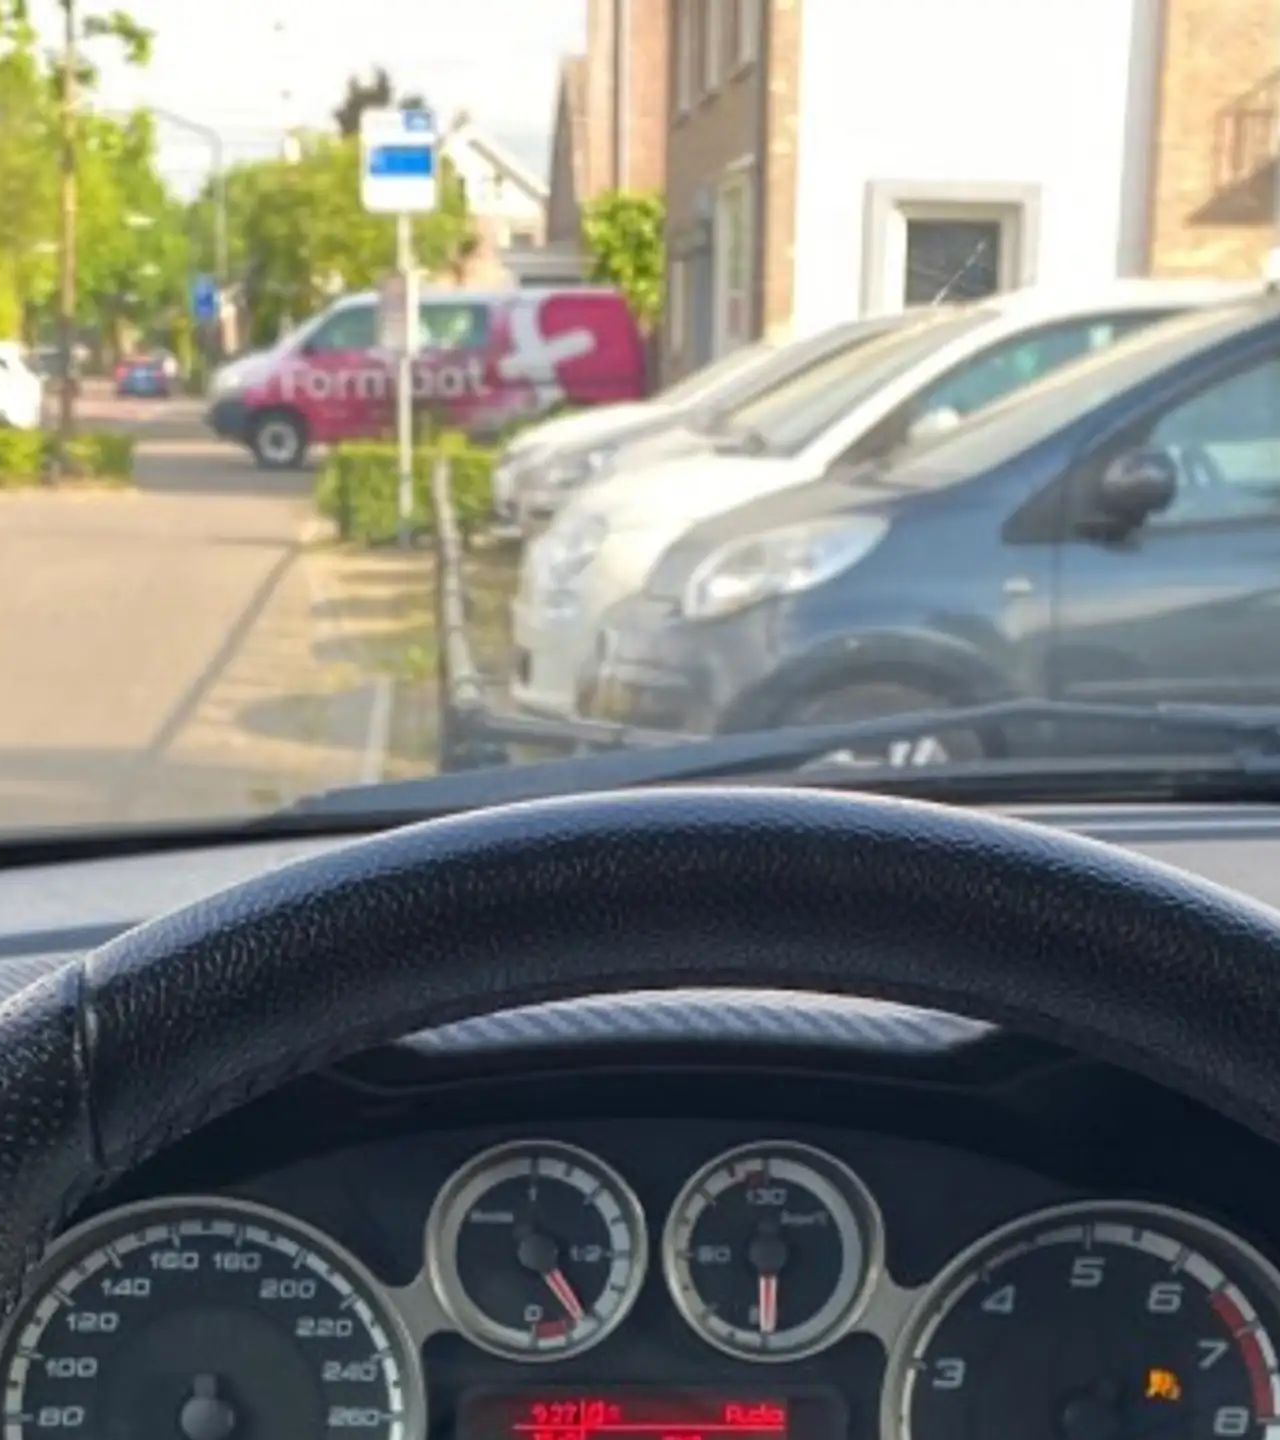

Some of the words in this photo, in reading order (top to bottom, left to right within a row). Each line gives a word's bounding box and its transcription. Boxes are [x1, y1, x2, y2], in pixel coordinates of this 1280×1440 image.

[150, 1252, 199, 1271] 160
[213, 1252, 262, 1271] 180
[1070, 1257, 1105, 1287] 5
[101, 1278, 151, 1296] 140
[259, 1280, 316, 1298] 200
[982, 1285, 1016, 1314] 4
[1147, 1283, 1183, 1313] 6
[67, 1313, 118, 1331] 120
[295, 1319, 353, 1337] 220
[1197, 1340, 1229, 1370] 7
[45, 1358, 98, 1378] 100
[323, 1362, 378, 1380] 240
[933, 1358, 965, 1389] 3
[37, 1408, 85, 1426] 80
[327, 1409, 380, 1426] 260
[1213, 1406, 1249, 1435] 8
